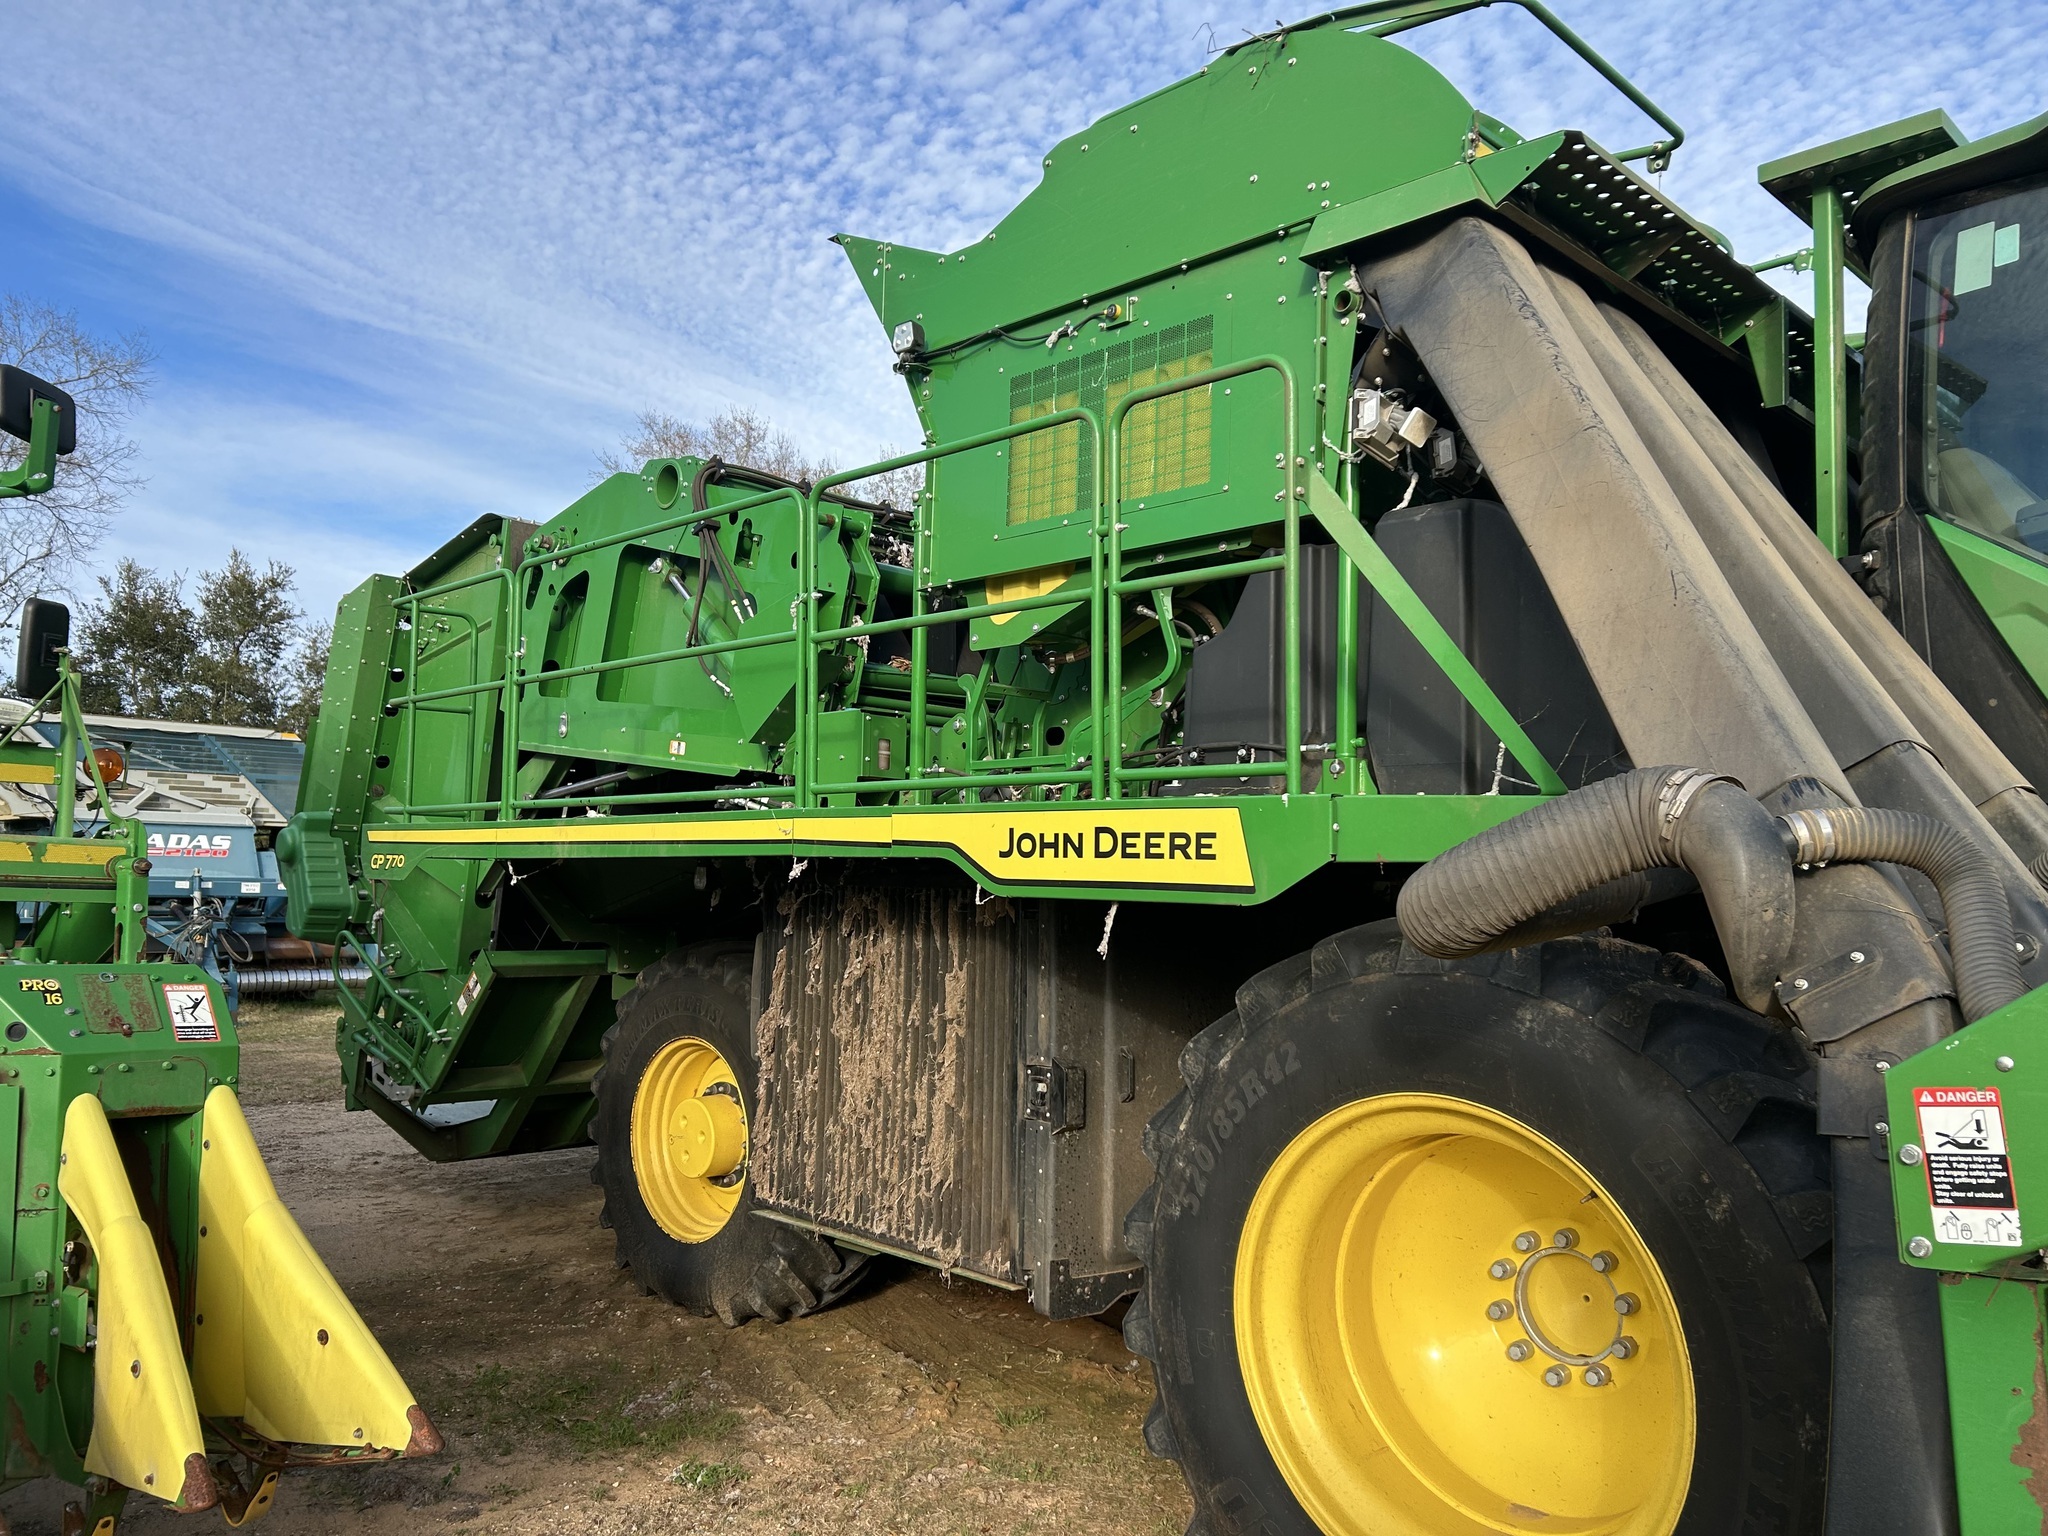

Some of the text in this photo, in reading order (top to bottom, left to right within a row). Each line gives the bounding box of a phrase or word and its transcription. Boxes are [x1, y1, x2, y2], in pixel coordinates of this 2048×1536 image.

[999, 827, 1217, 860] JOHN DEERE
[371, 854, 405, 870] CP 770
[20, 978, 61, 992] PRO
[44, 992, 63, 1005] 16
[1935, 1090, 1997, 1103] DANGER
[1952, 1162, 1968, 1170] Fully
